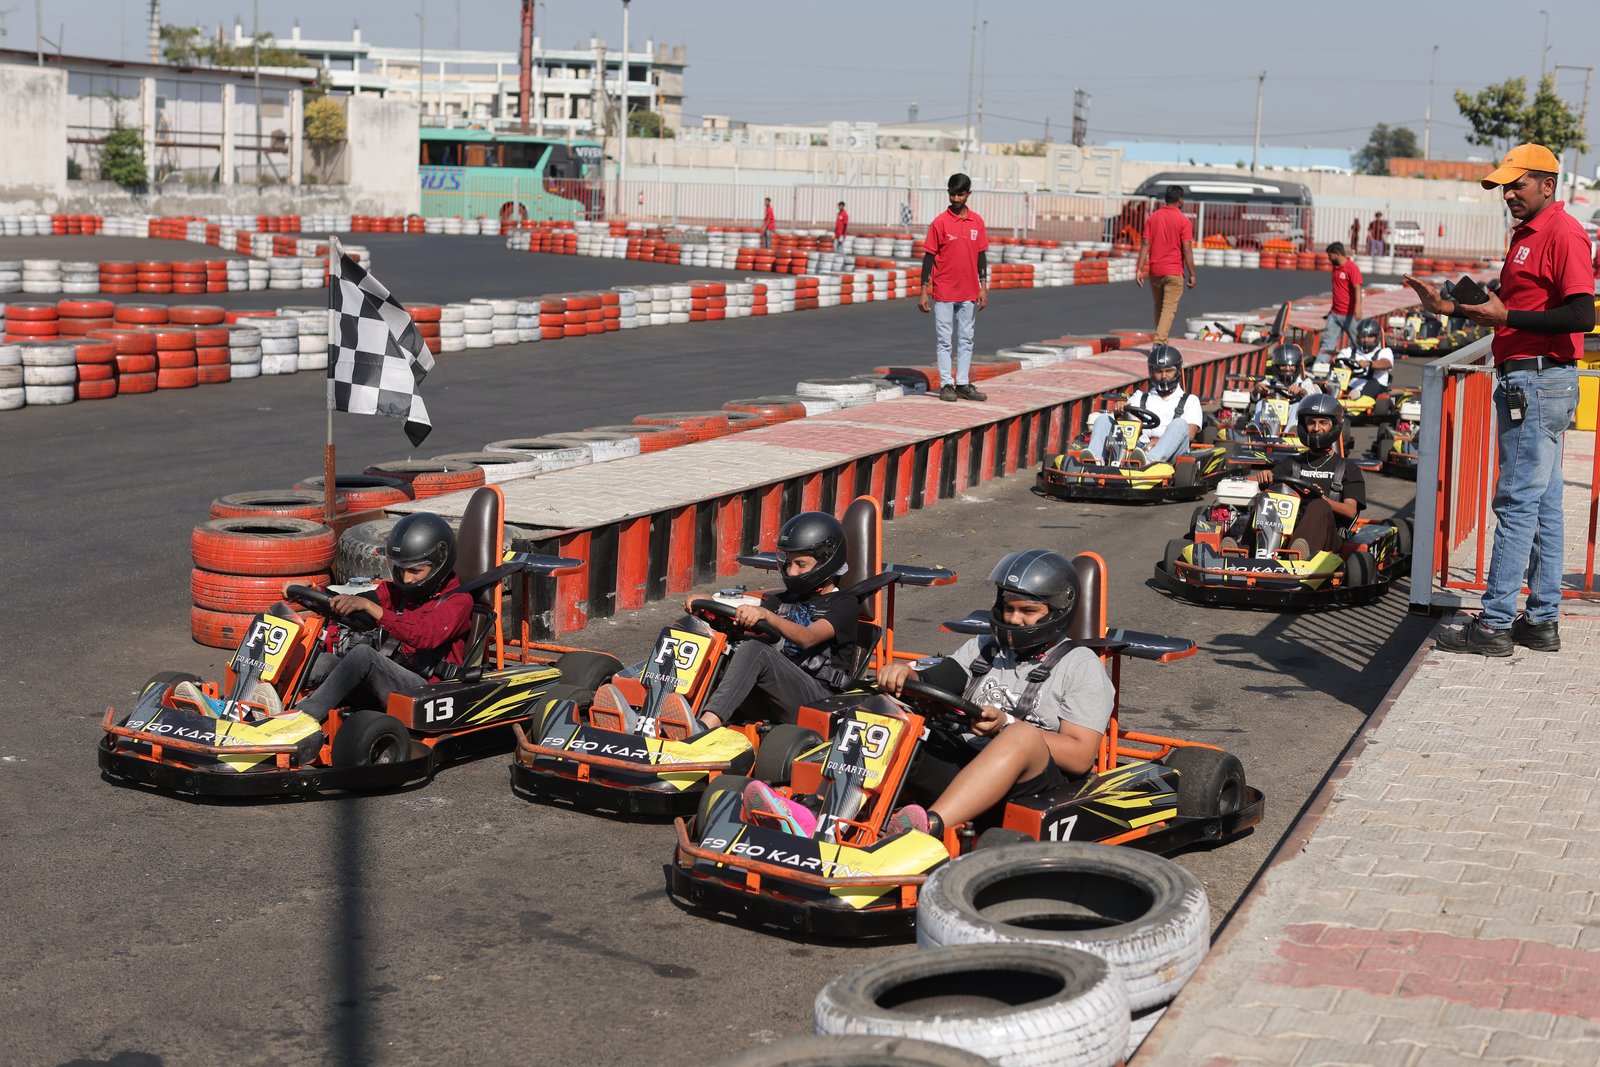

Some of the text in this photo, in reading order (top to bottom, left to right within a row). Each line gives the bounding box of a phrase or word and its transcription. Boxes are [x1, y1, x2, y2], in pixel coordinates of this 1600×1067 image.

[1515, 245, 1530, 261] F9
[1264, 402, 1285, 415] F9
[1111, 424, 1136, 438] F9
[1260, 497, 1293, 518] F9
[245, 620, 289, 655] F9
[654, 636, 700, 670] F9
[236, 655, 274, 672] GO KARTING
[645, 671, 688, 688] GO KARTING
[423, 696, 454, 723] 13
[146, 722, 173, 732] GO
[569, 739, 599, 751] GO
[837, 719, 891, 760] F9
[826, 761, 879, 780] GO KARTING
[1048, 814, 1078, 842] 17
[700, 837, 727, 849] F9
[731, 842, 765, 857] GO
